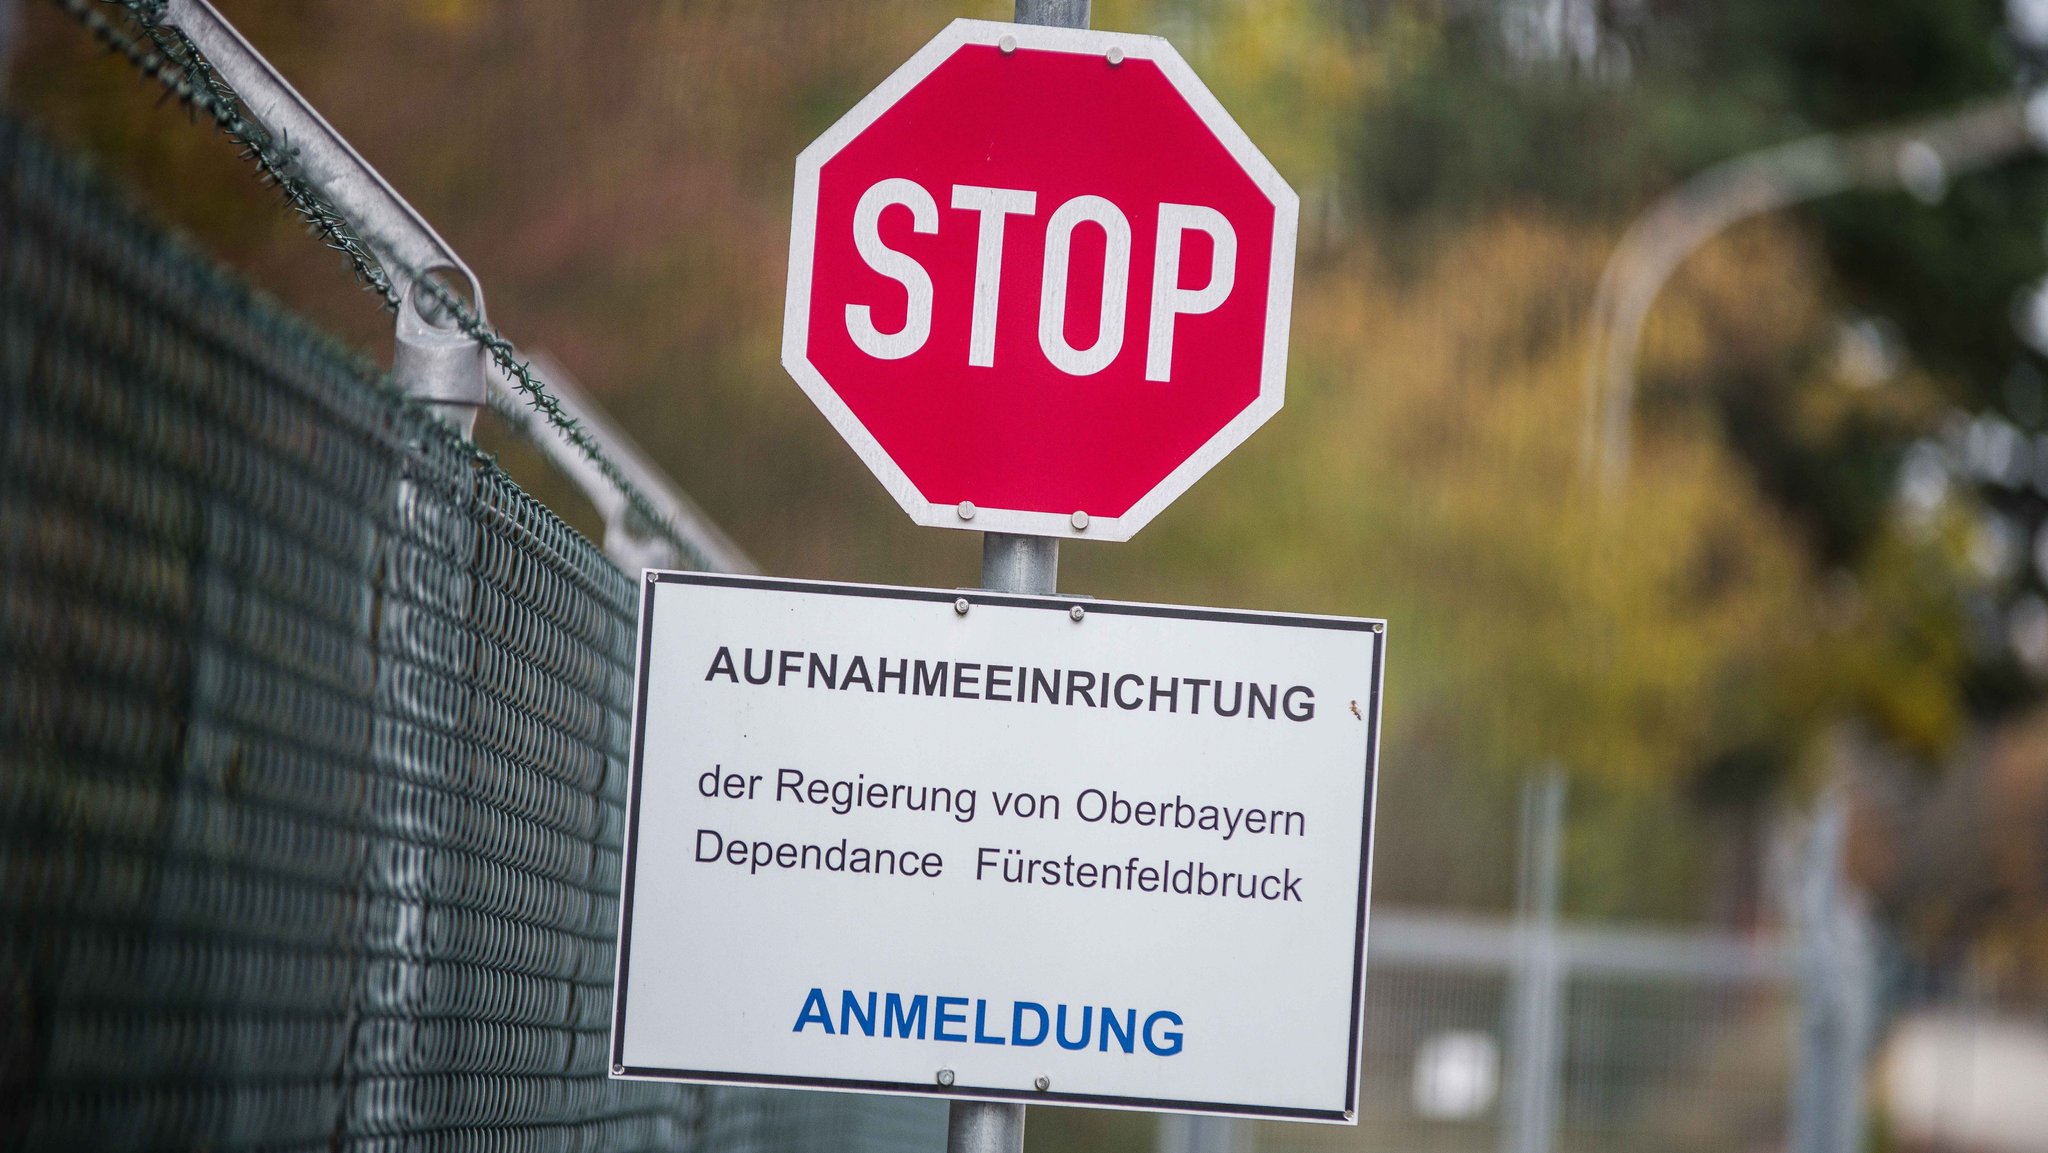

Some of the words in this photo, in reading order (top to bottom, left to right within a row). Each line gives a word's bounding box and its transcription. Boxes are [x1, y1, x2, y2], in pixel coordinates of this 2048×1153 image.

[844, 177, 1238, 383] STOP
[705, 647, 1314, 722] AUFNAHMEEINRICHTUNG
[699, 765, 763, 799] der
[777, 769, 976, 822] Regierung
[992, 792, 1059, 819] von
[1077, 789, 1304, 837] Oberbayern
[695, 829, 942, 877] Dependance
[977, 848, 1302, 902] Fürstenfeldbruck
[792, 988, 1183, 1056] ANMELDUNG
